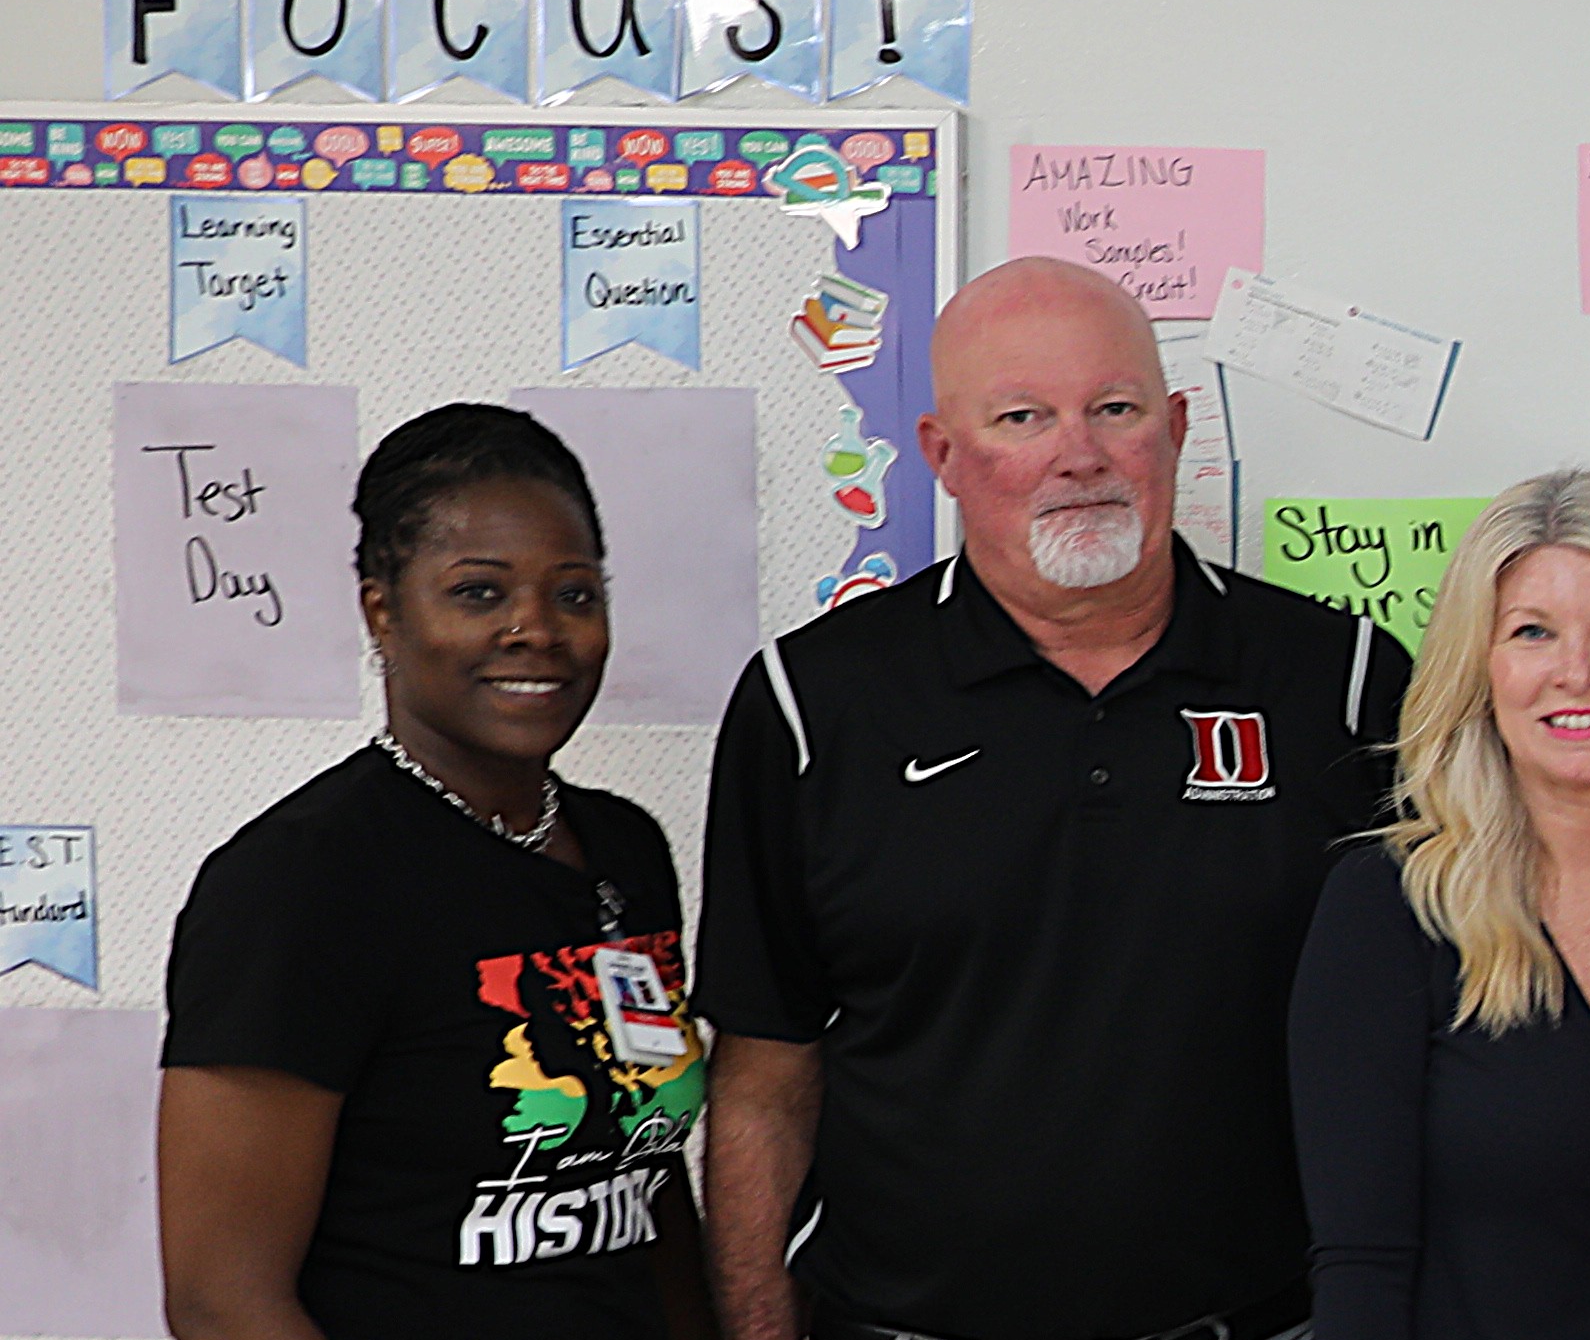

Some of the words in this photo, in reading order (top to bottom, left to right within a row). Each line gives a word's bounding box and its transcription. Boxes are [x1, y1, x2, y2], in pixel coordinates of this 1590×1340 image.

[1022, 153, 1194, 192] AMAZING
[180, 205, 297, 248] Learning
[571, 210, 687, 249] Essential
[1058, 201, 1119, 233] Work
[1085, 229, 1185, 270] Samples!
[180, 261, 289, 310] Target
[585, 271, 697, 310] Question
[142, 445, 266, 521] Test
[1275, 505, 1390, 589] Stay
[1408, 519, 1449, 554] in
[185, 537, 285, 627] Day
